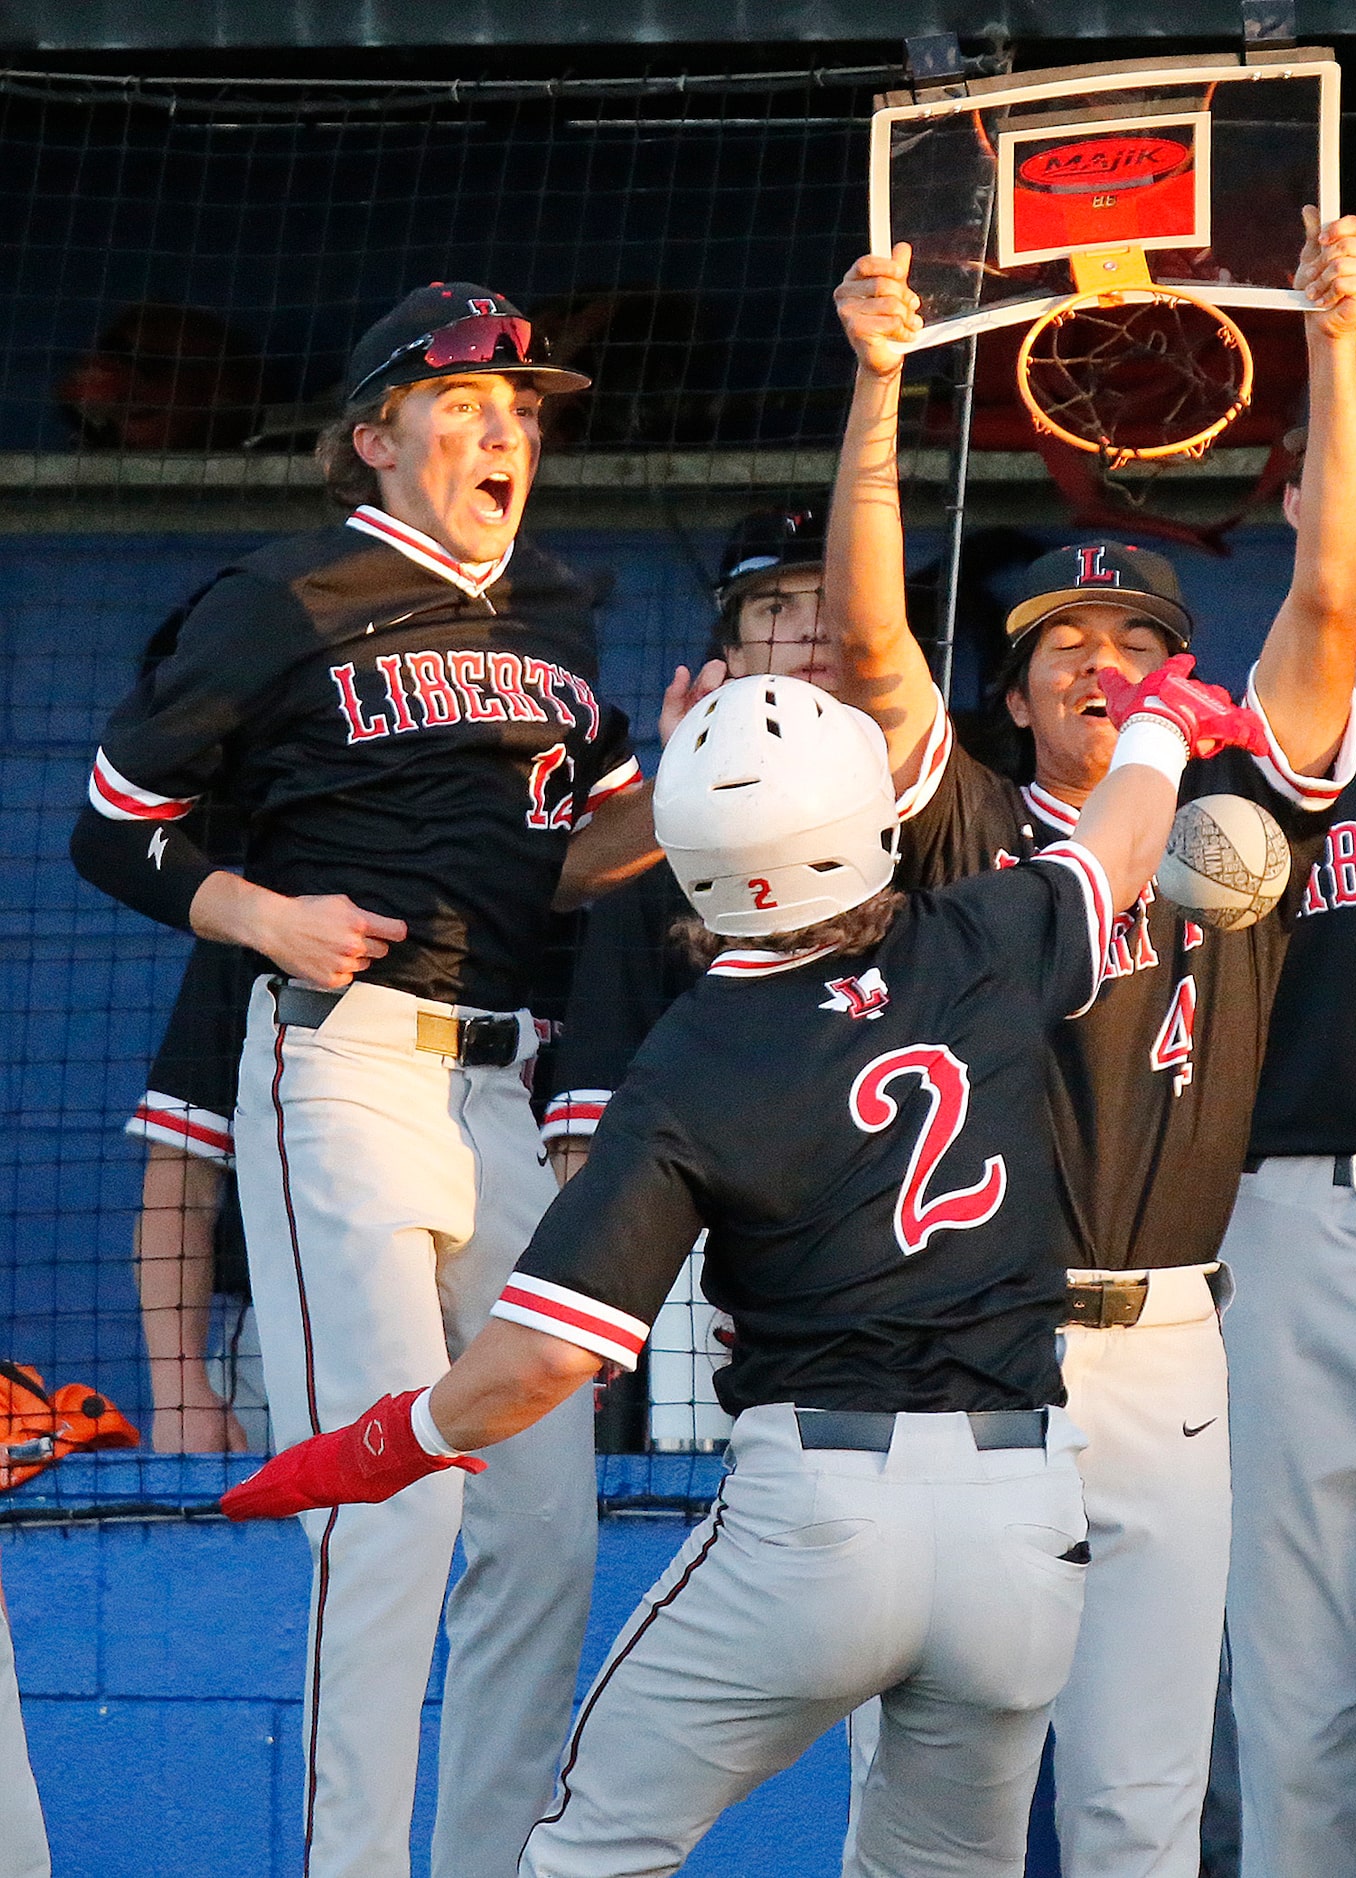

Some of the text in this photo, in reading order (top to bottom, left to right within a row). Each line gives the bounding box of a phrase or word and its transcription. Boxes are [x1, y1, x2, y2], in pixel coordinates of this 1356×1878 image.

[1076, 545, 1120, 587] L
[330, 651, 599, 745] LIBERTY
[747, 878, 778, 910] 2
[1150, 974, 1197, 1098] 4
[849, 1043, 1008, 1256] 2
